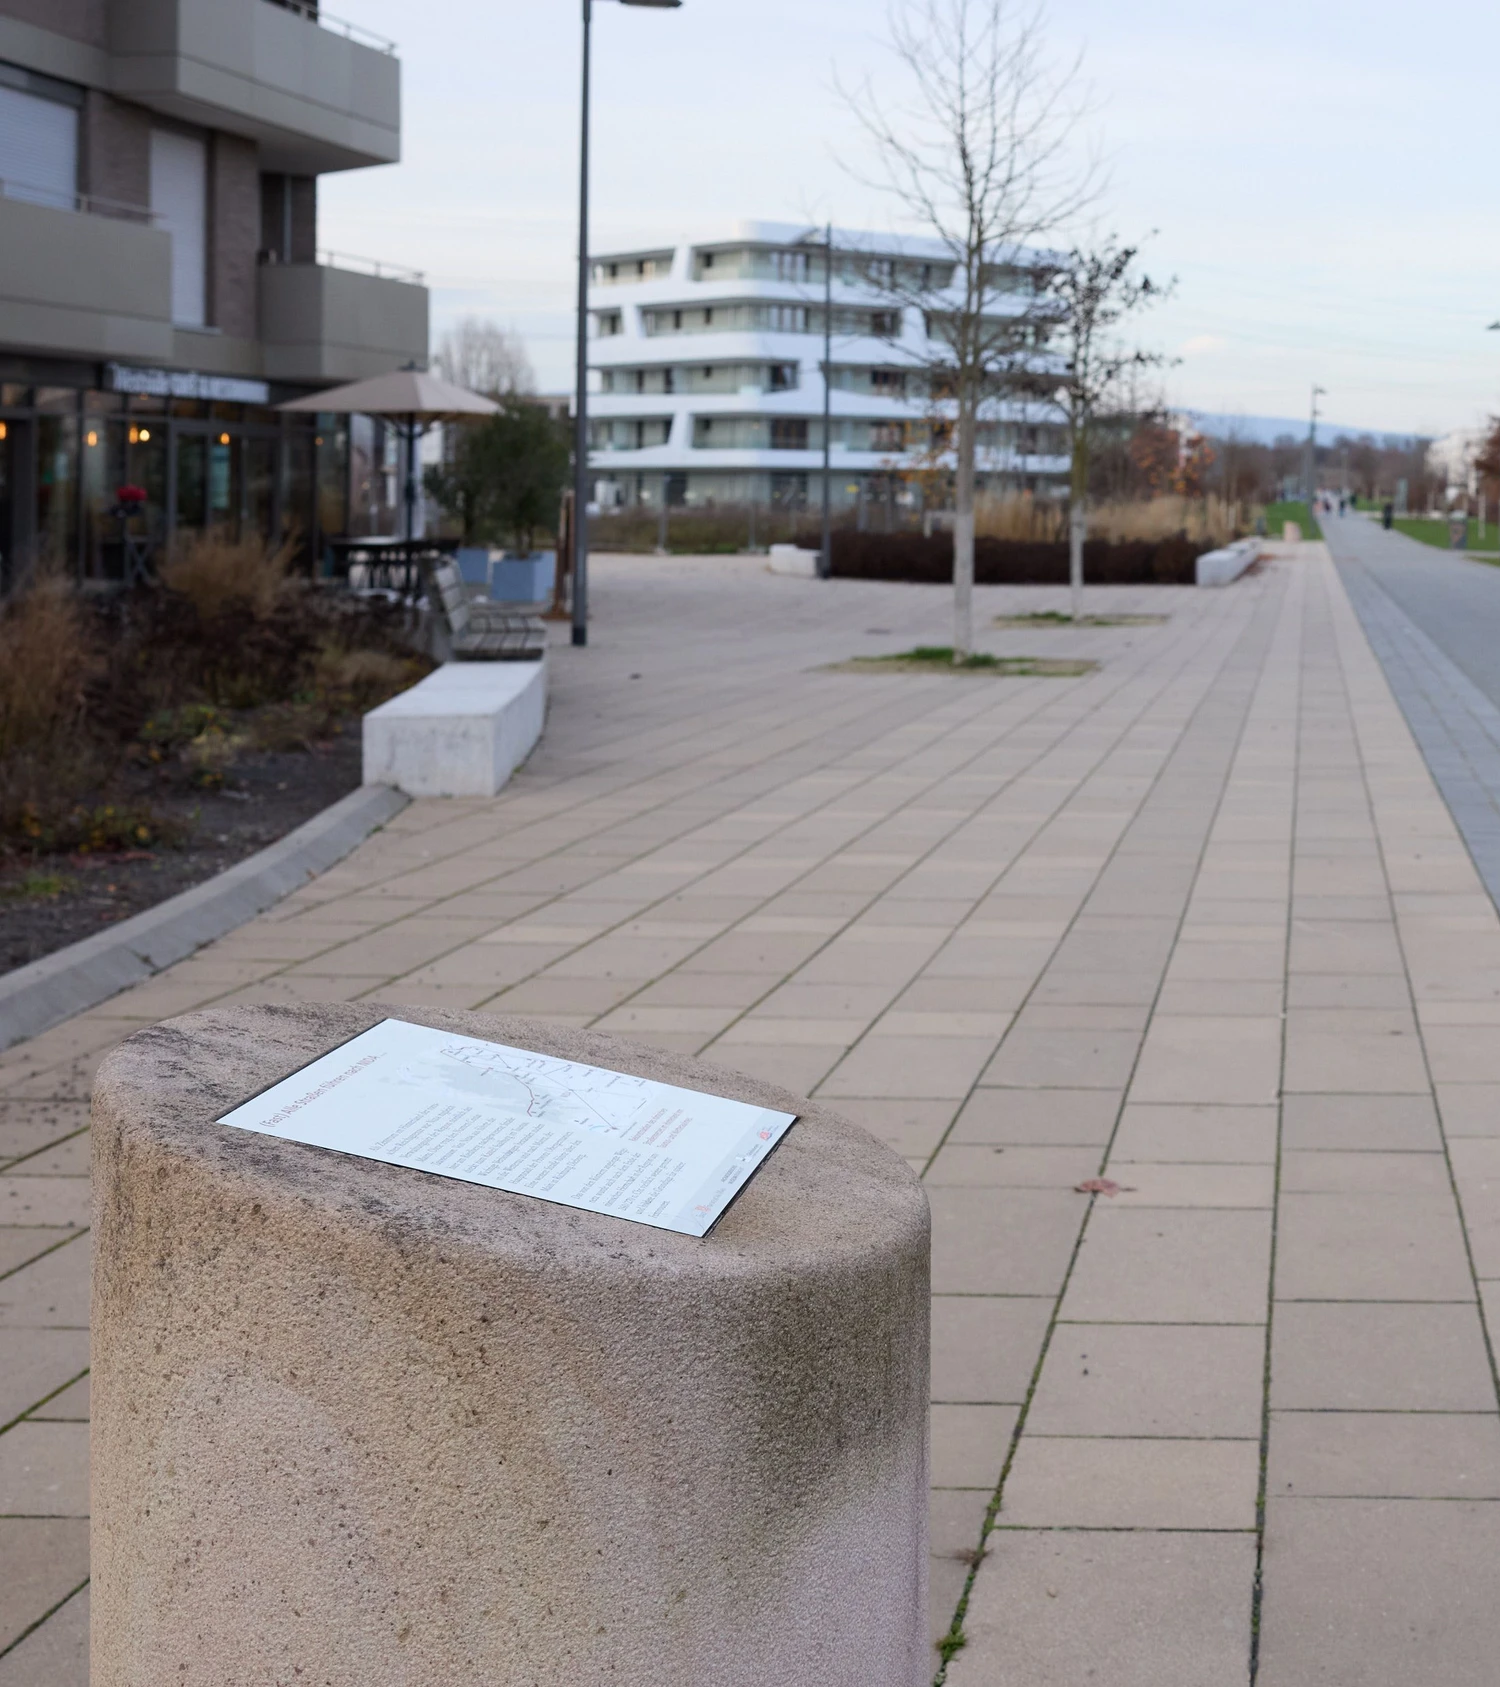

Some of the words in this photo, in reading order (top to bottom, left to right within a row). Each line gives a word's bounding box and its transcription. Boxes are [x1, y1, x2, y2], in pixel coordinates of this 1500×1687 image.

[292, 1087, 328, 1106] Straßen
[318, 1073, 349, 1091] führen
[342, 1063, 364, 1077] nach
